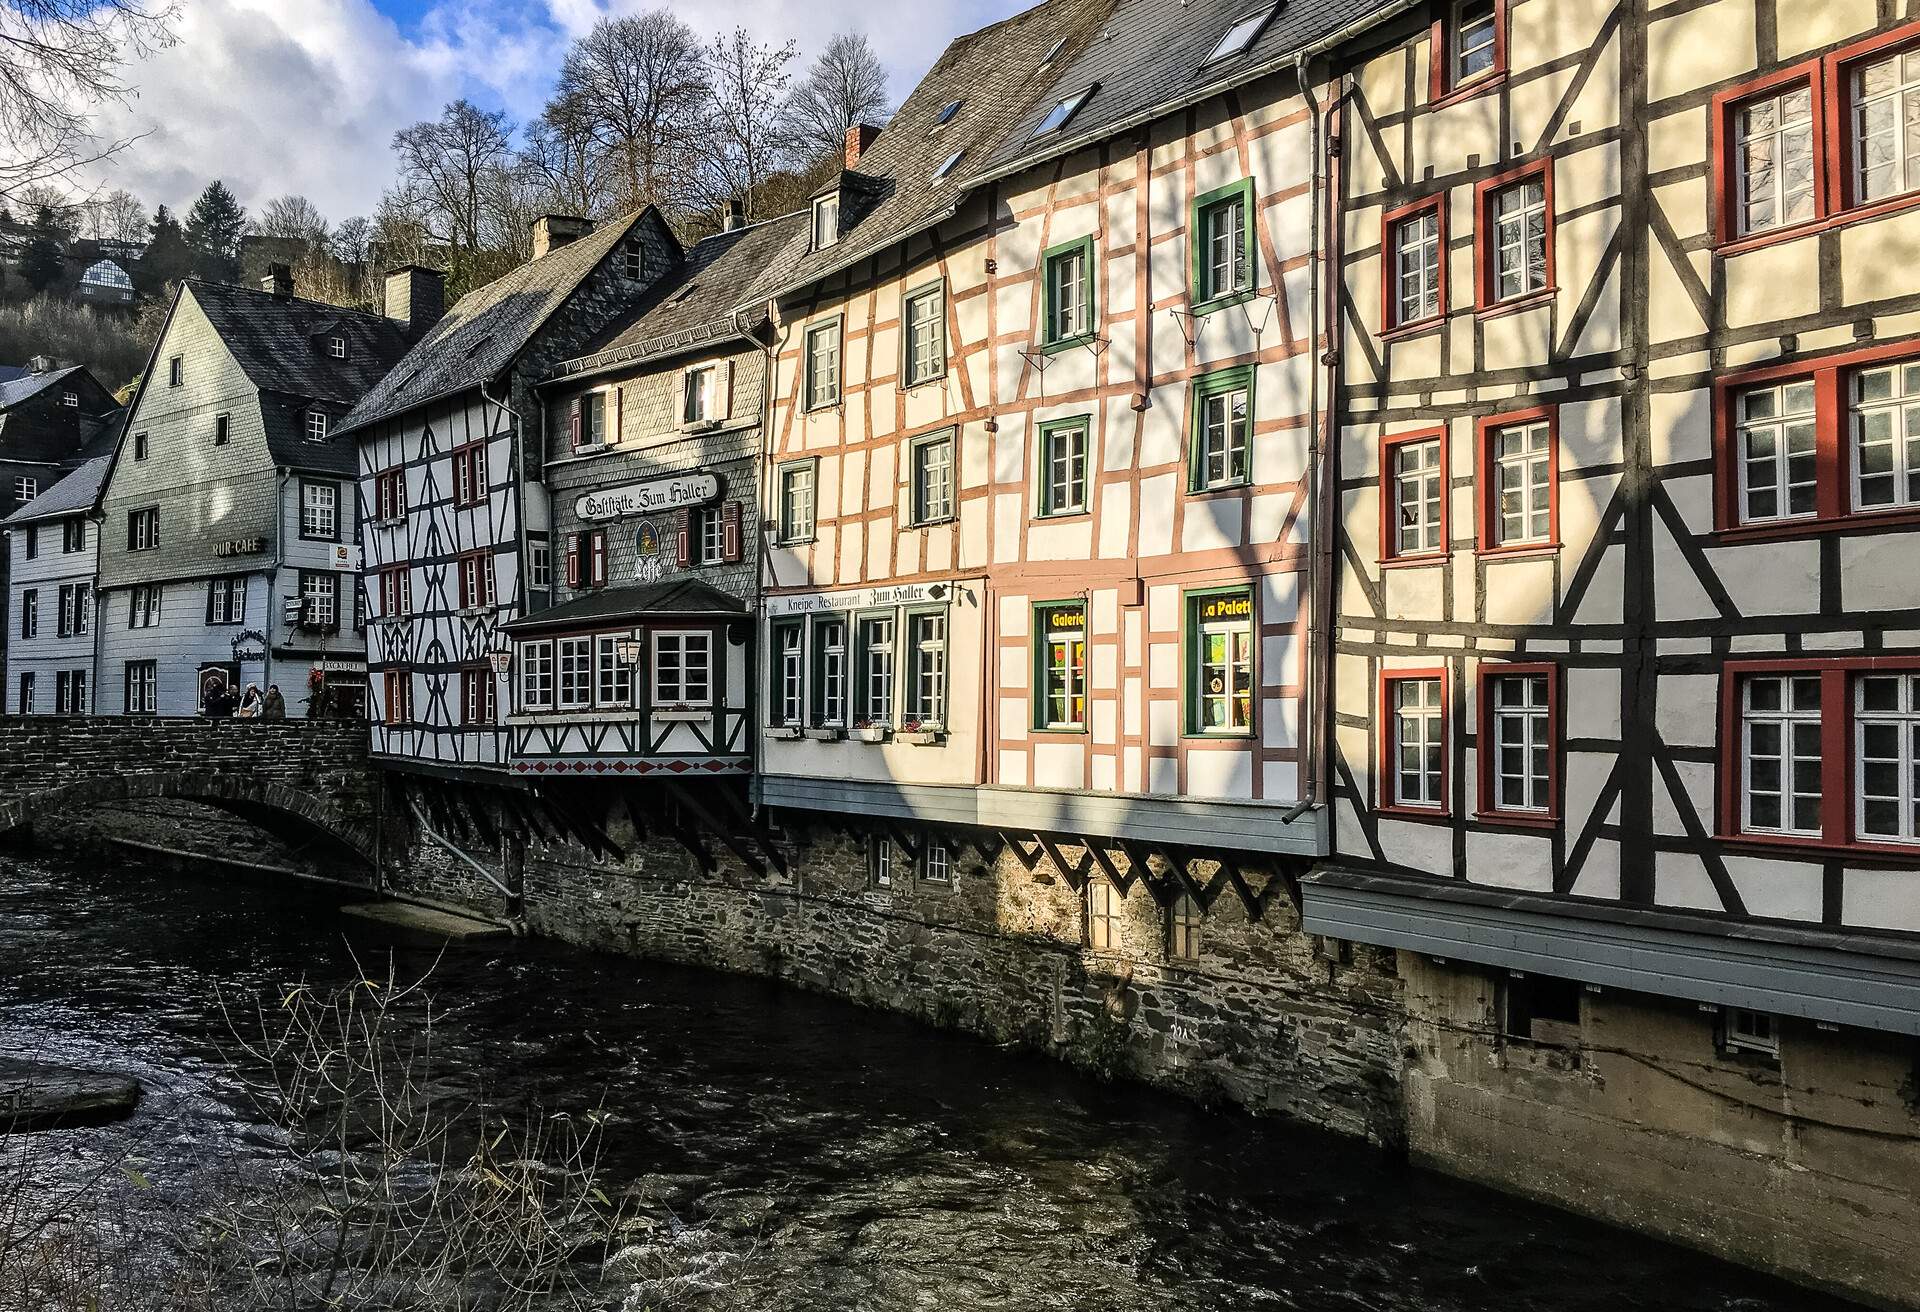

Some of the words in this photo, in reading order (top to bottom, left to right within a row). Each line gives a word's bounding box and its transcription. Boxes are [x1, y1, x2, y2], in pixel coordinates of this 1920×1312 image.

[788, 598, 814, 613] Kneipe
[818, 594, 860, 609] Restaurant
[869, 588, 890, 606] Zum
[892, 584, 924, 602] Haller
[1217, 600, 1251, 616] Palett
[1052, 612, 1085, 627] Galerie
